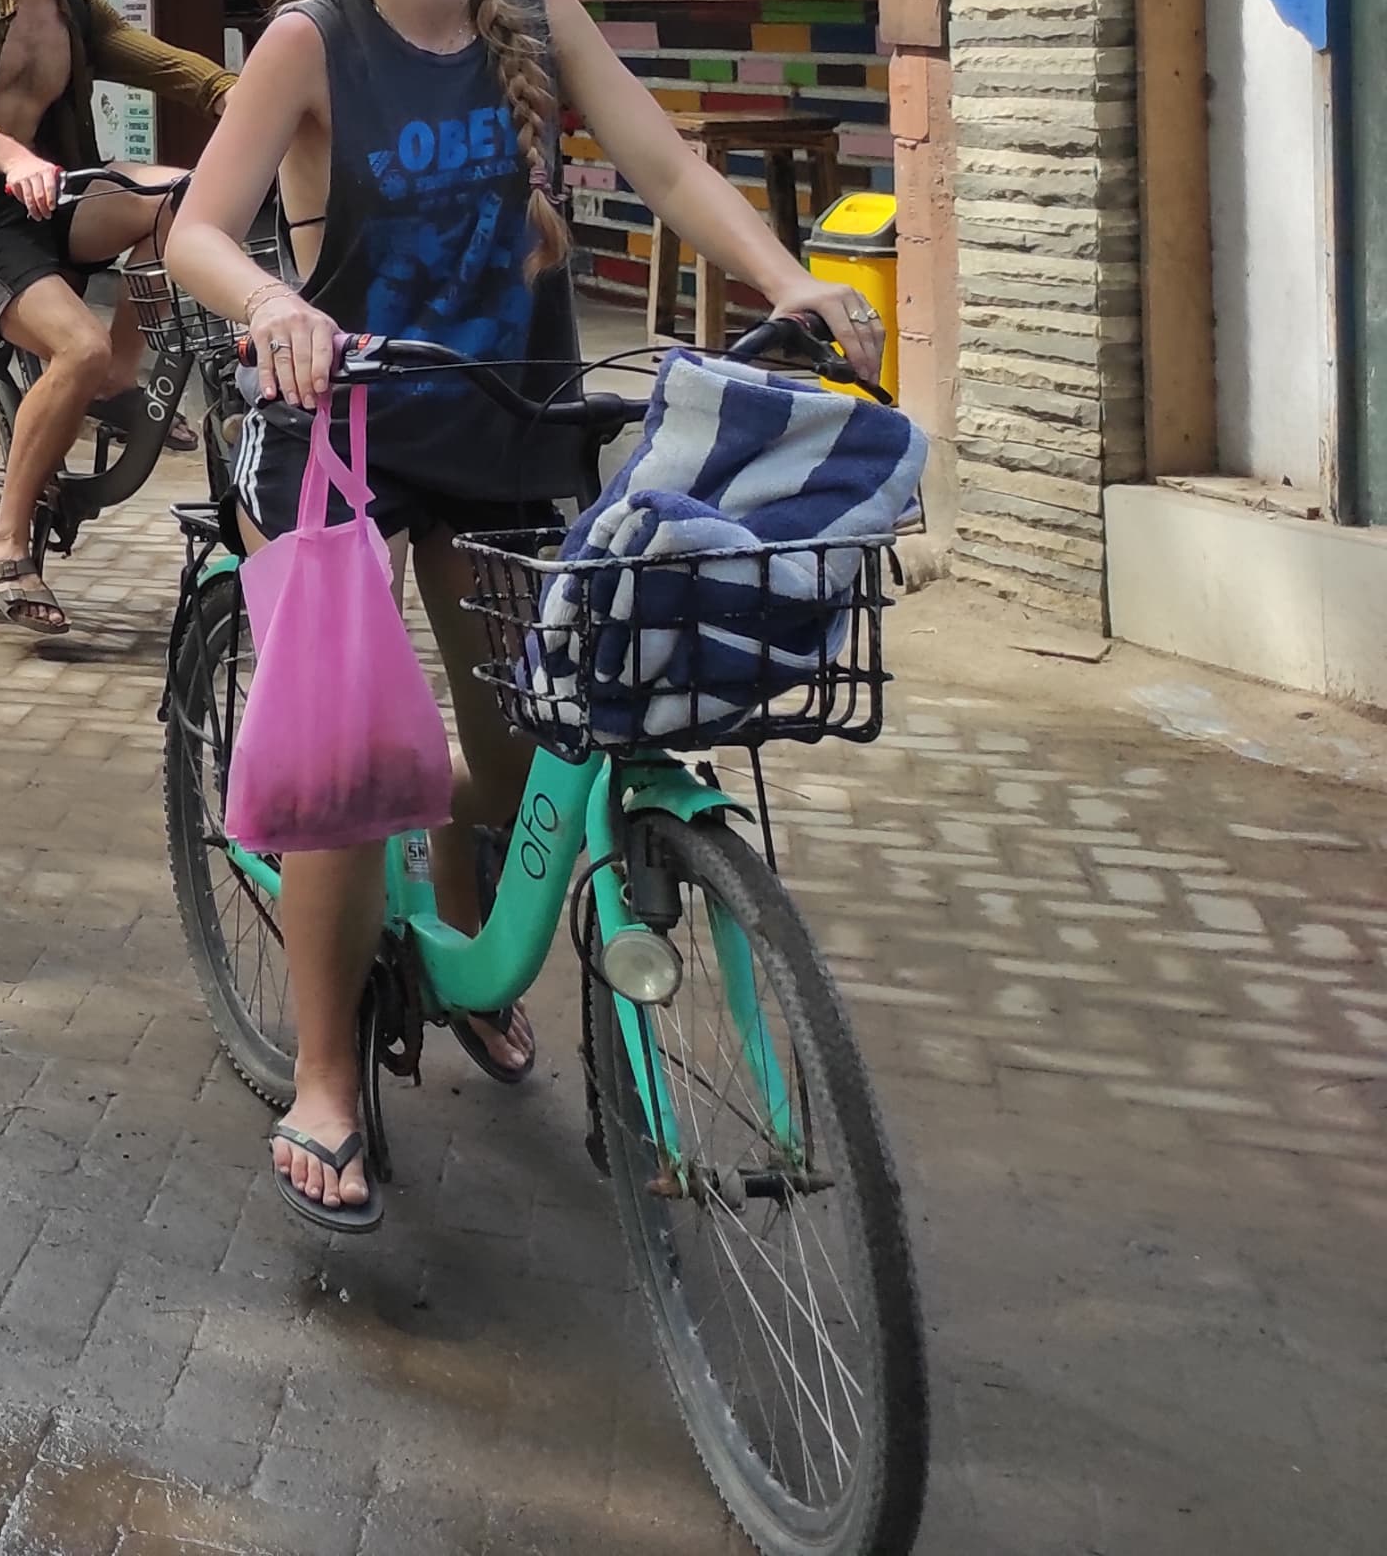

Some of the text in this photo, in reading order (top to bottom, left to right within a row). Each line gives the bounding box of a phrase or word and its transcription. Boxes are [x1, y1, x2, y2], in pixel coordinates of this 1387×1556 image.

[398, 107, 518, 172] OBEY
[147, 376, 174, 421] ofo
[521, 792, 559, 880] ofo
